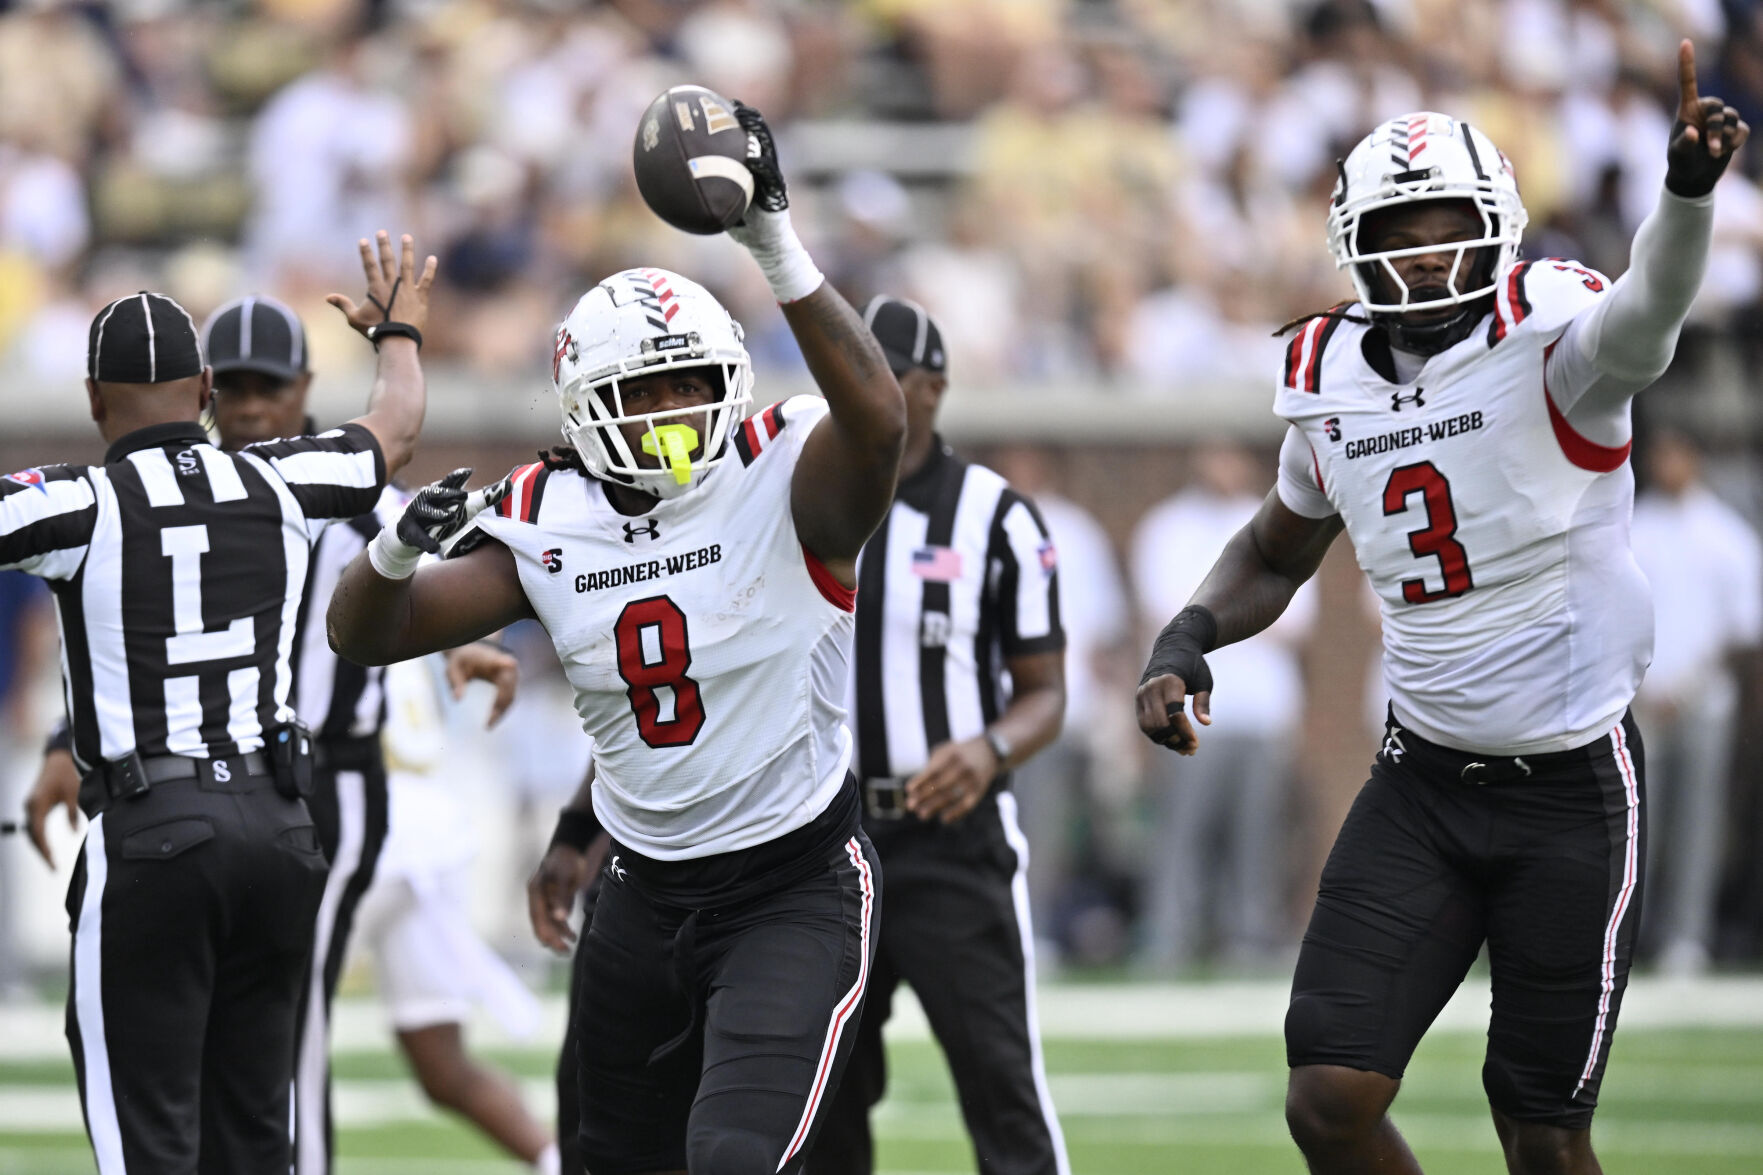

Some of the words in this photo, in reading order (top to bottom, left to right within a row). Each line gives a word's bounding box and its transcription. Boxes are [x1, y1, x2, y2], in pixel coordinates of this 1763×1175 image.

[1345, 410, 1483, 460] GARDNER-WEBB
[575, 543, 722, 594] GARDNER-WEBB
[1382, 460, 1474, 605] 3
[161, 525, 255, 665] L
[613, 594, 706, 749] 8
[212, 760, 231, 782] S
